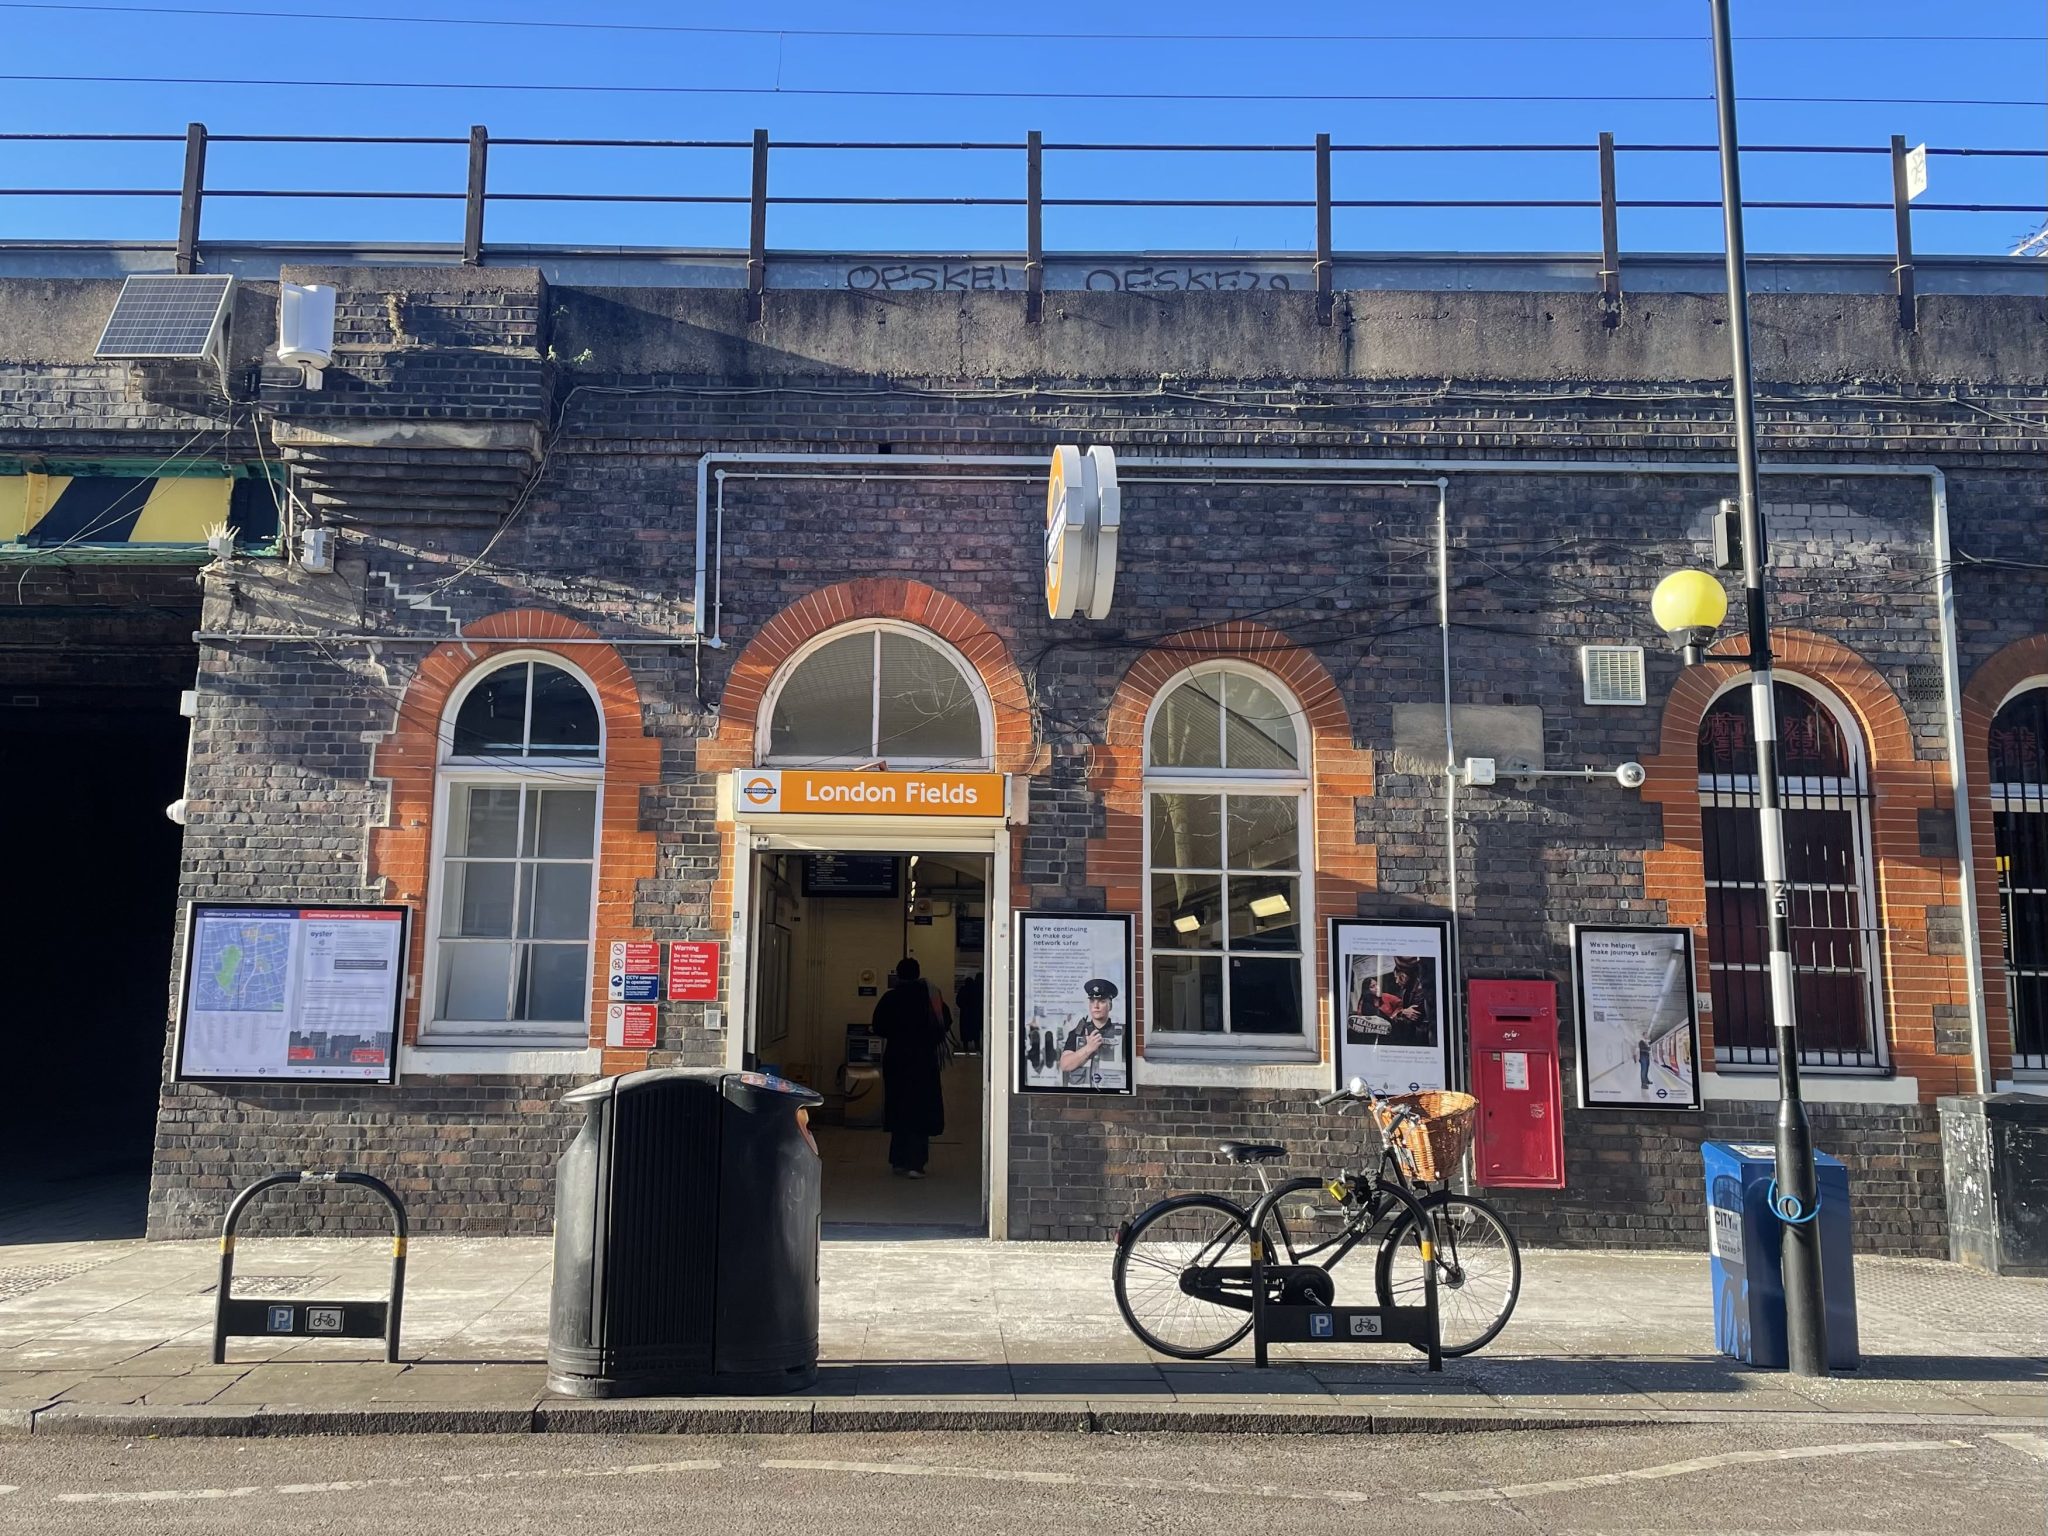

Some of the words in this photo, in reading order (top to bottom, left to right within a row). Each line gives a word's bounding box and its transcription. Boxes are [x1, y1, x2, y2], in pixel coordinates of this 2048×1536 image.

[806, 780, 896, 803] London
[905, 781, 978, 805] Fields
[1714, 1210, 1732, 1229] CITY
[274, 1310, 288, 1328] P
[1316, 1316, 1329, 1334] P
